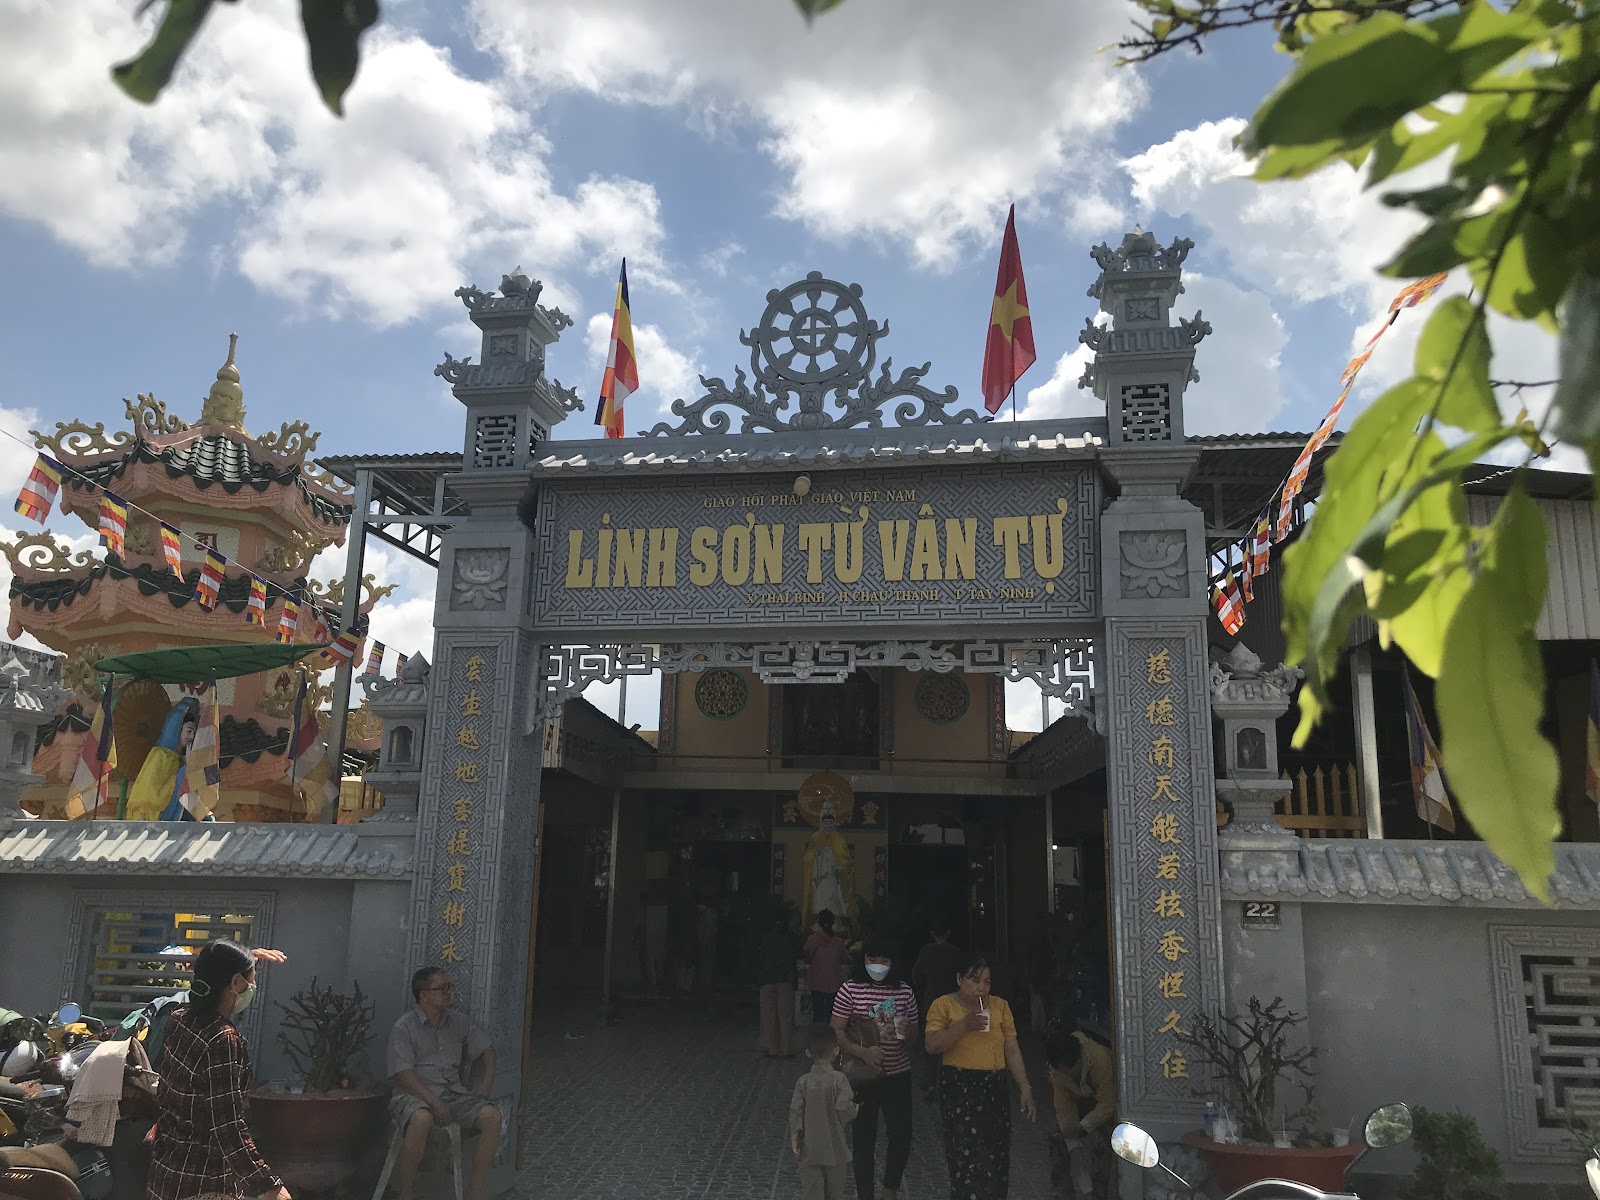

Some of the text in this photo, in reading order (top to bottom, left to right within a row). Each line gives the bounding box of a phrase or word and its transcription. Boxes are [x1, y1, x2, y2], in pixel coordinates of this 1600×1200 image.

[703, 493, 735, 508] GIÁO
[741, 492, 765, 509] HỘI
[811, 489, 844, 505] GIÁO
[849, 488, 880, 505] VIỆT
[886, 489, 916, 502] NAM
[689, 512, 785, 587] SƠN
[798, 504, 869, 584] TỪ
[877, 503, 978, 581] VÂN
[993, 497, 1068, 595] TỰ
[1000, 587, 1035, 599] NINH
[1246, 902, 1275, 917] 22
